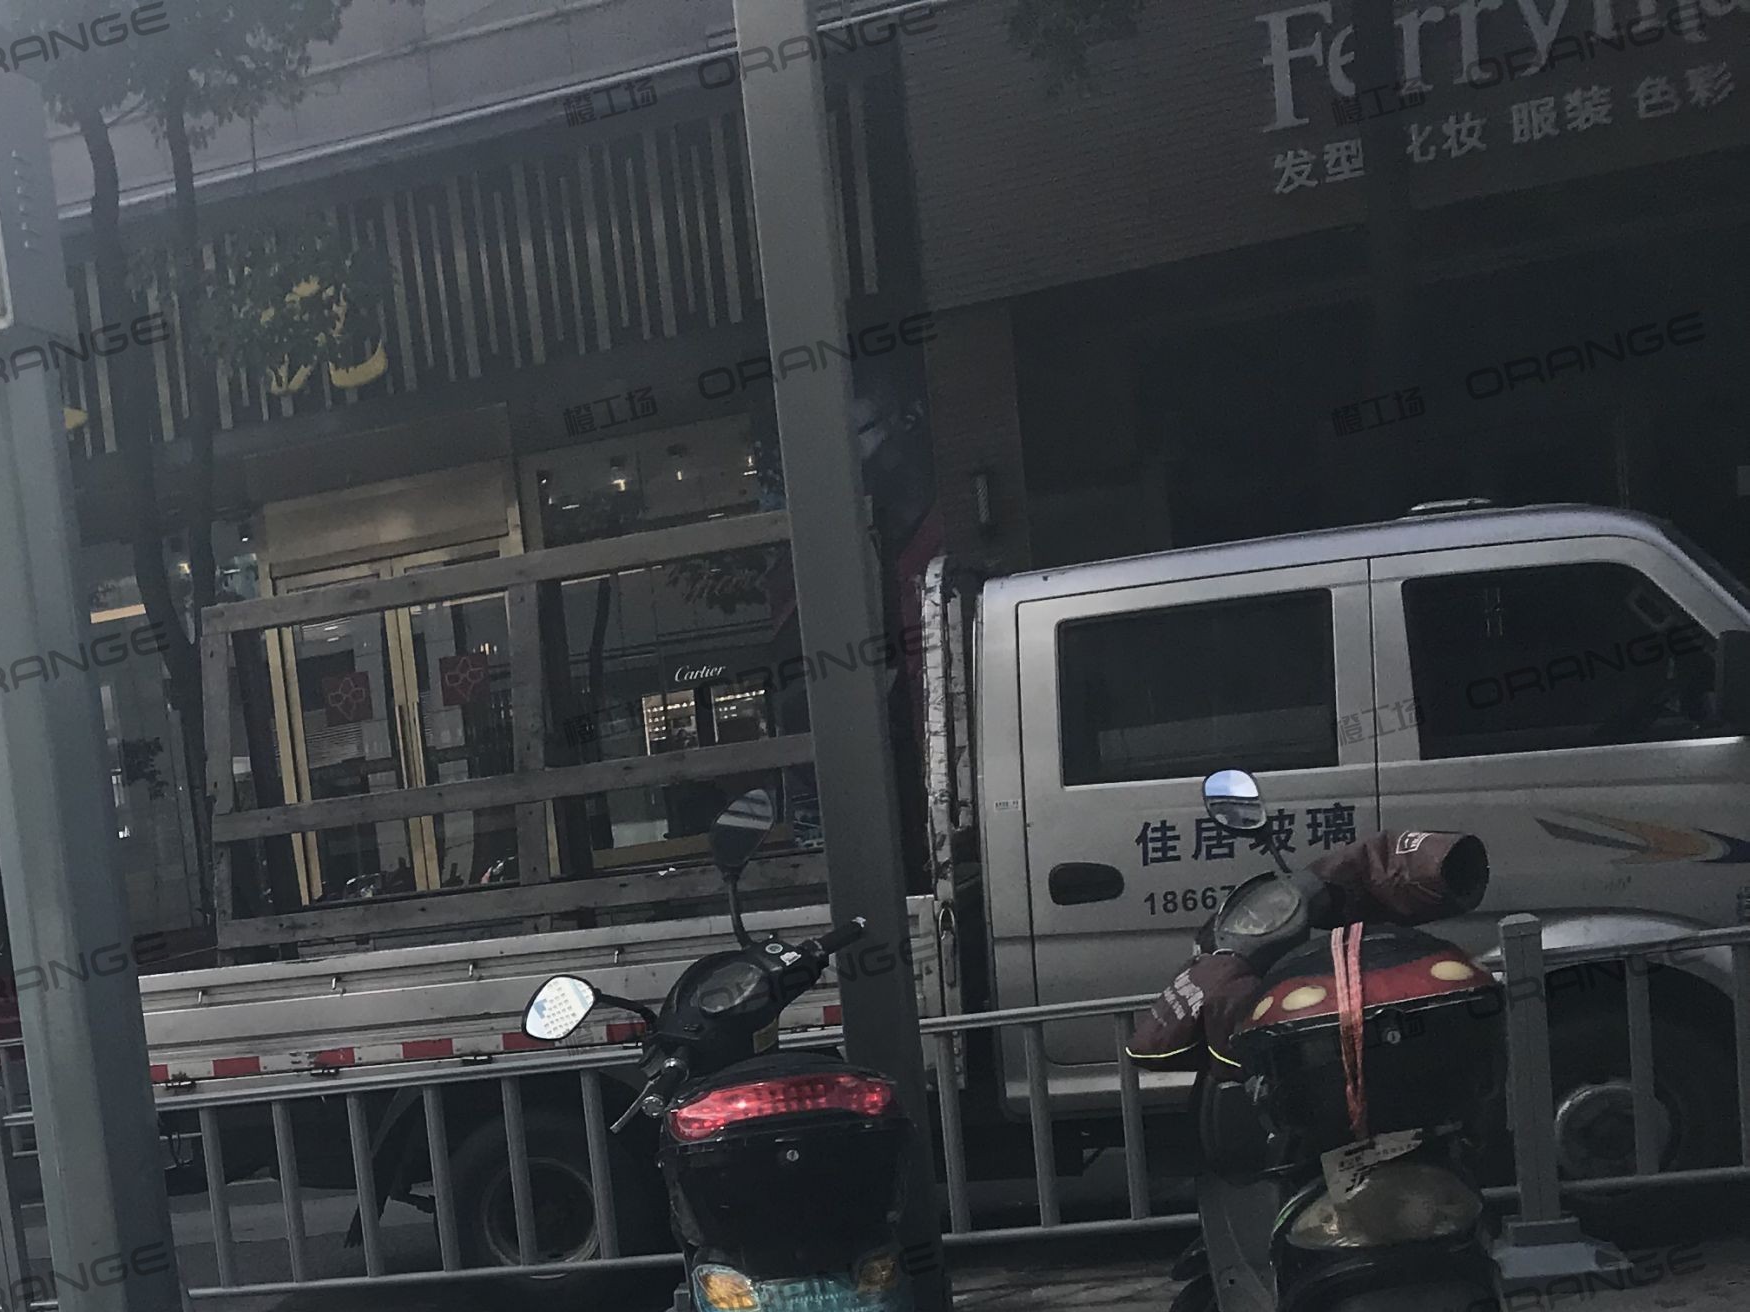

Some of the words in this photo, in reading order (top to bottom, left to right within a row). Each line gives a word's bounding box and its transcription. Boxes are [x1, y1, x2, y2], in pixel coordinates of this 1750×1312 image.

[1253, 0, 1750, 133] Ferry
[1272, 137, 1366, 195] 发型
[1510, 85, 1614, 145] 服装
[1629, 61, 1736, 120] 色彩
[674, 664, 727, 683] Cartier
[1135, 801, 1358, 868] 佳居玻璃
